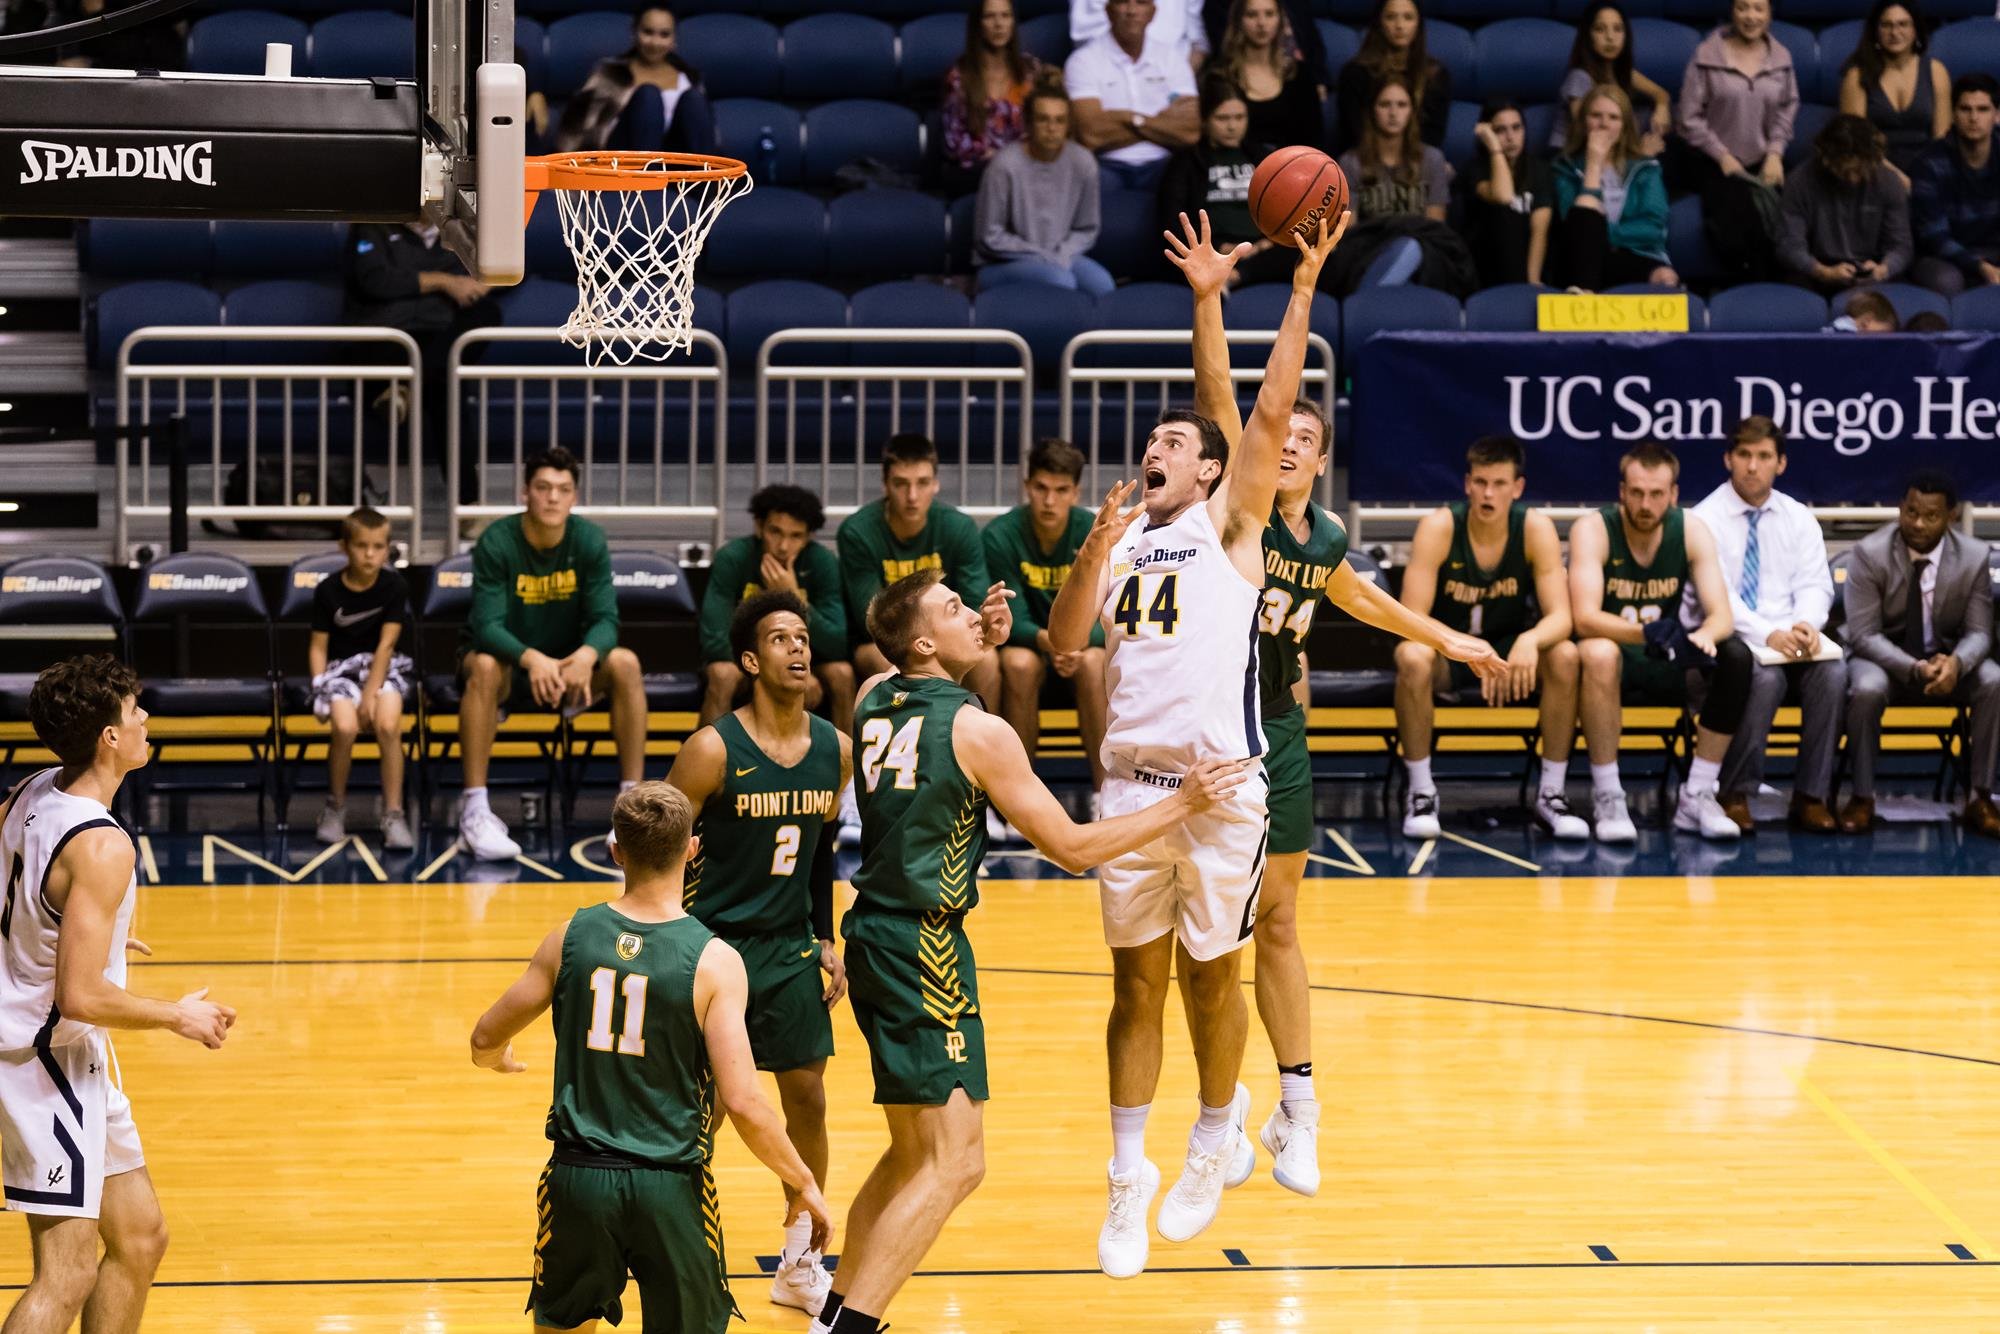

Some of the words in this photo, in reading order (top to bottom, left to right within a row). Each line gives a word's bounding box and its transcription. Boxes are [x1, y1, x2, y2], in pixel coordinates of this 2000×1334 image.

[20, 140, 213, 186] SPALDING
[1288, 184, 1336, 238] Wilson
[1504, 376, 1602, 440] UC
[1612, 376, 1726, 440] San
[1735, 376, 1904, 456] Diego
[1264, 547, 1302, 585] OINT
[1114, 573, 1181, 637] 44
[1259, 587, 1316, 644] 34
[1470, 604, 1483, 634] 1
[862, 716, 925, 794] 24
[735, 792, 791, 818] POINT
[770, 824, 802, 877] 2
[586, 966, 649, 1058] 11
